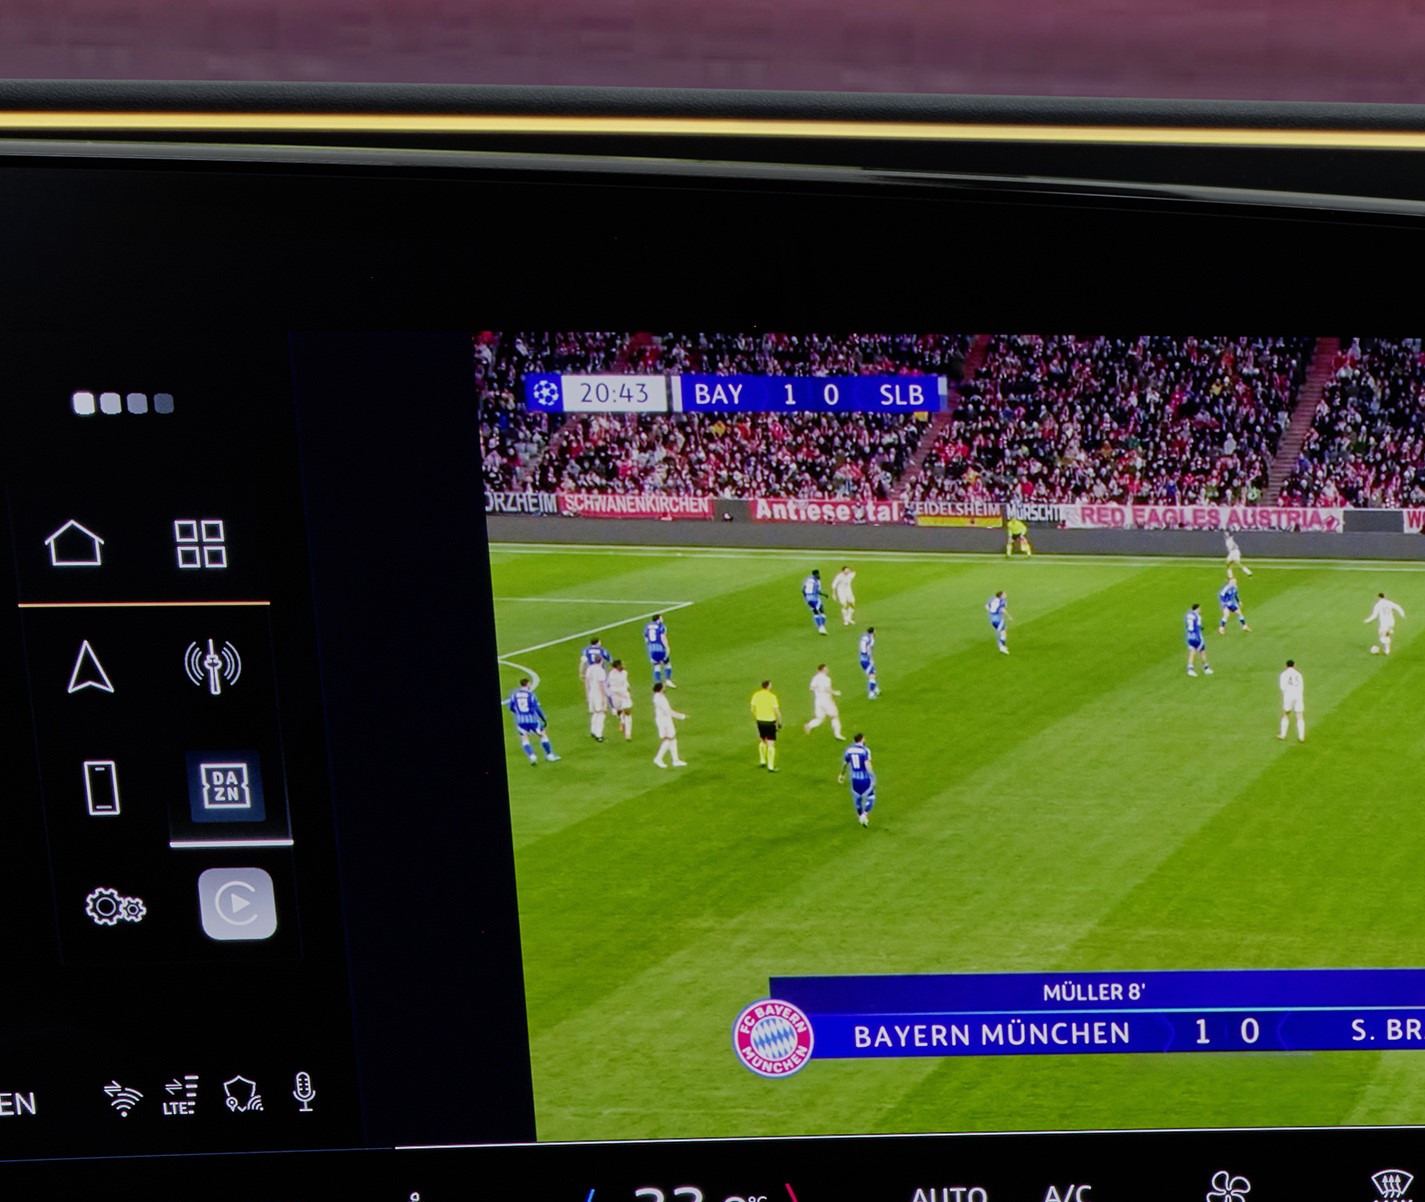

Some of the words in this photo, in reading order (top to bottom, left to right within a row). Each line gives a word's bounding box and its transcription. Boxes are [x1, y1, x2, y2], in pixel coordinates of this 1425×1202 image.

[580, 384, 649, 403] 20:43
[695, 383, 743, 405] BAY
[784, 384, 796, 405] 1
[823, 384, 839, 405] 0
[880, 384, 924, 406] SLB
[564, 493, 710, 513] SCHWANENKIRCHEN
[756, 498, 899, 521] Antiesetal
[1080, 506, 1124, 526] RED
[1132, 507, 1221, 529] EAGLES
[1226, 508, 1324, 530] AUSTRIA
[1043, 980, 1124, 1001] MÜLLER
[754, 1004, 808, 1033] BAYERN
[1351, 1018, 1375, 1041] S.
[854, 1025, 970, 1048] BAYERN
[980, 1018, 1129, 1046] MÜNCHEN
[1196, 1019, 1210, 1043] 1
[1241, 1018, 1260, 1043] 0
[162, 1102, 188, 1115] LTE
